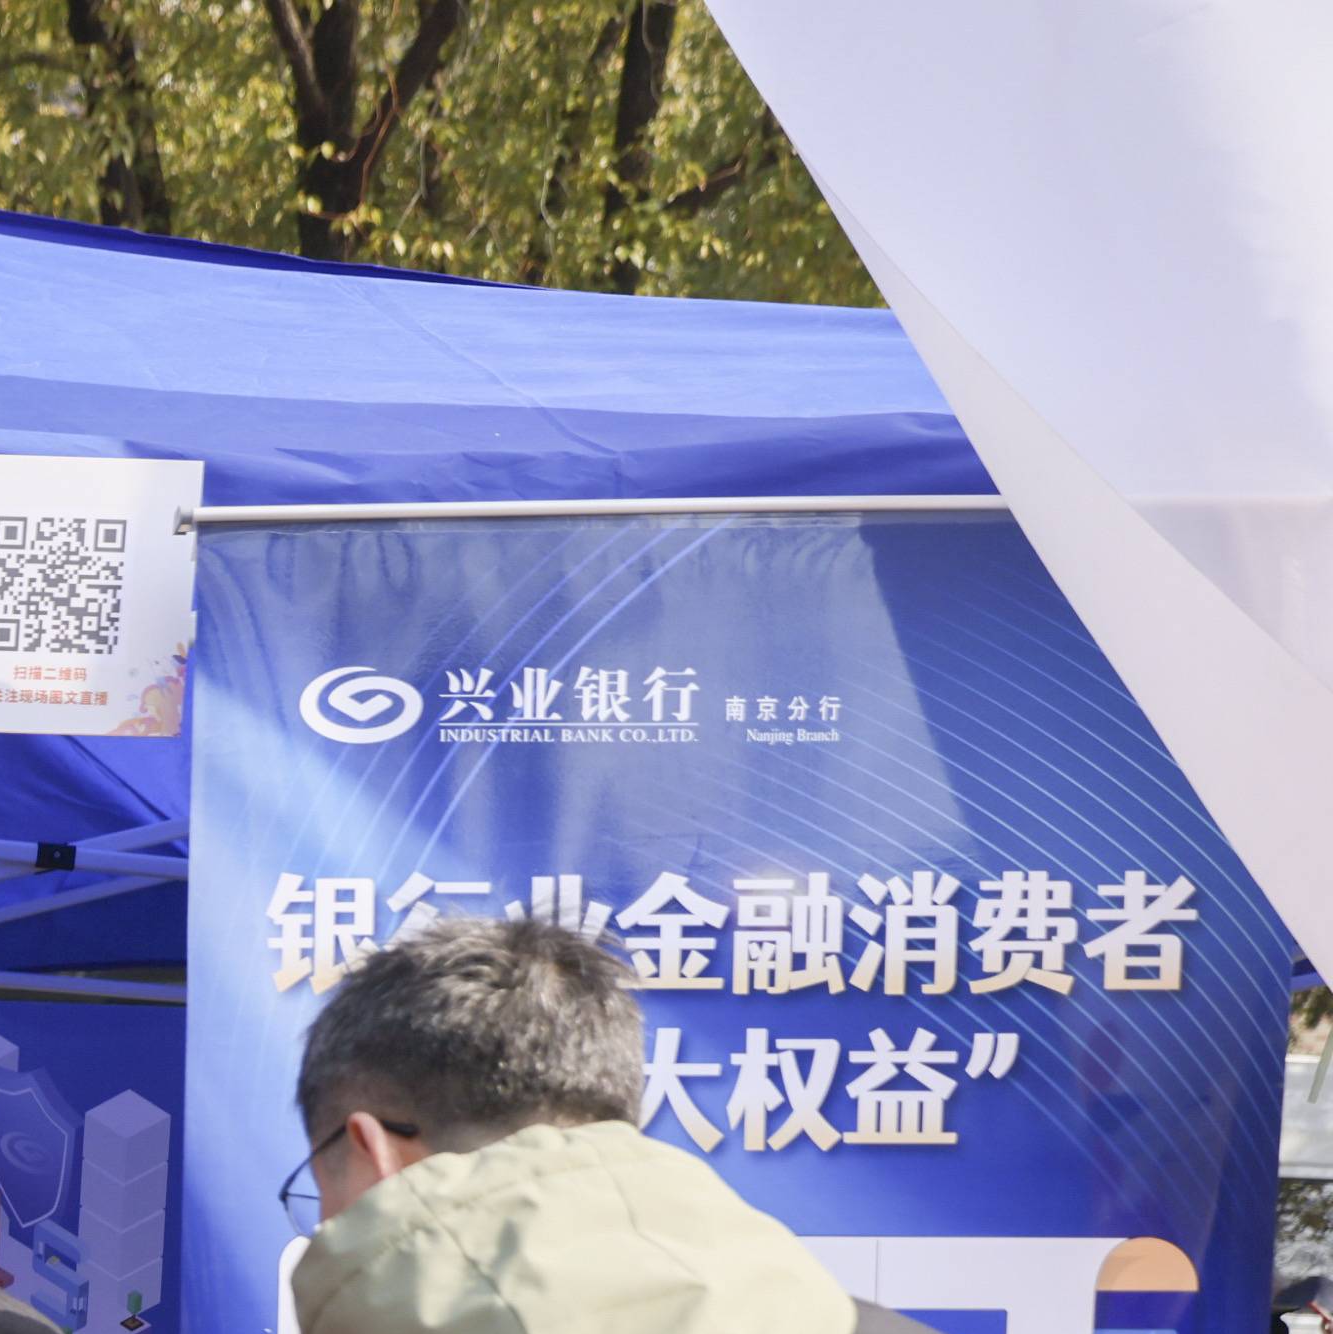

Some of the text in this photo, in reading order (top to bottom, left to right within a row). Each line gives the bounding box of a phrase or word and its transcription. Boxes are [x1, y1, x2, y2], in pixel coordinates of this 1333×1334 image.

[13, 666, 88, 682] 扫描二维码
[439, 666, 701, 722] 兴业银行
[724, 695, 843, 722] 南京分行
[440, 728, 555, 743] INDUSTRIAL
[561, 729, 614, 743] BANK
[746, 727, 840, 746] Nanjing Branch
